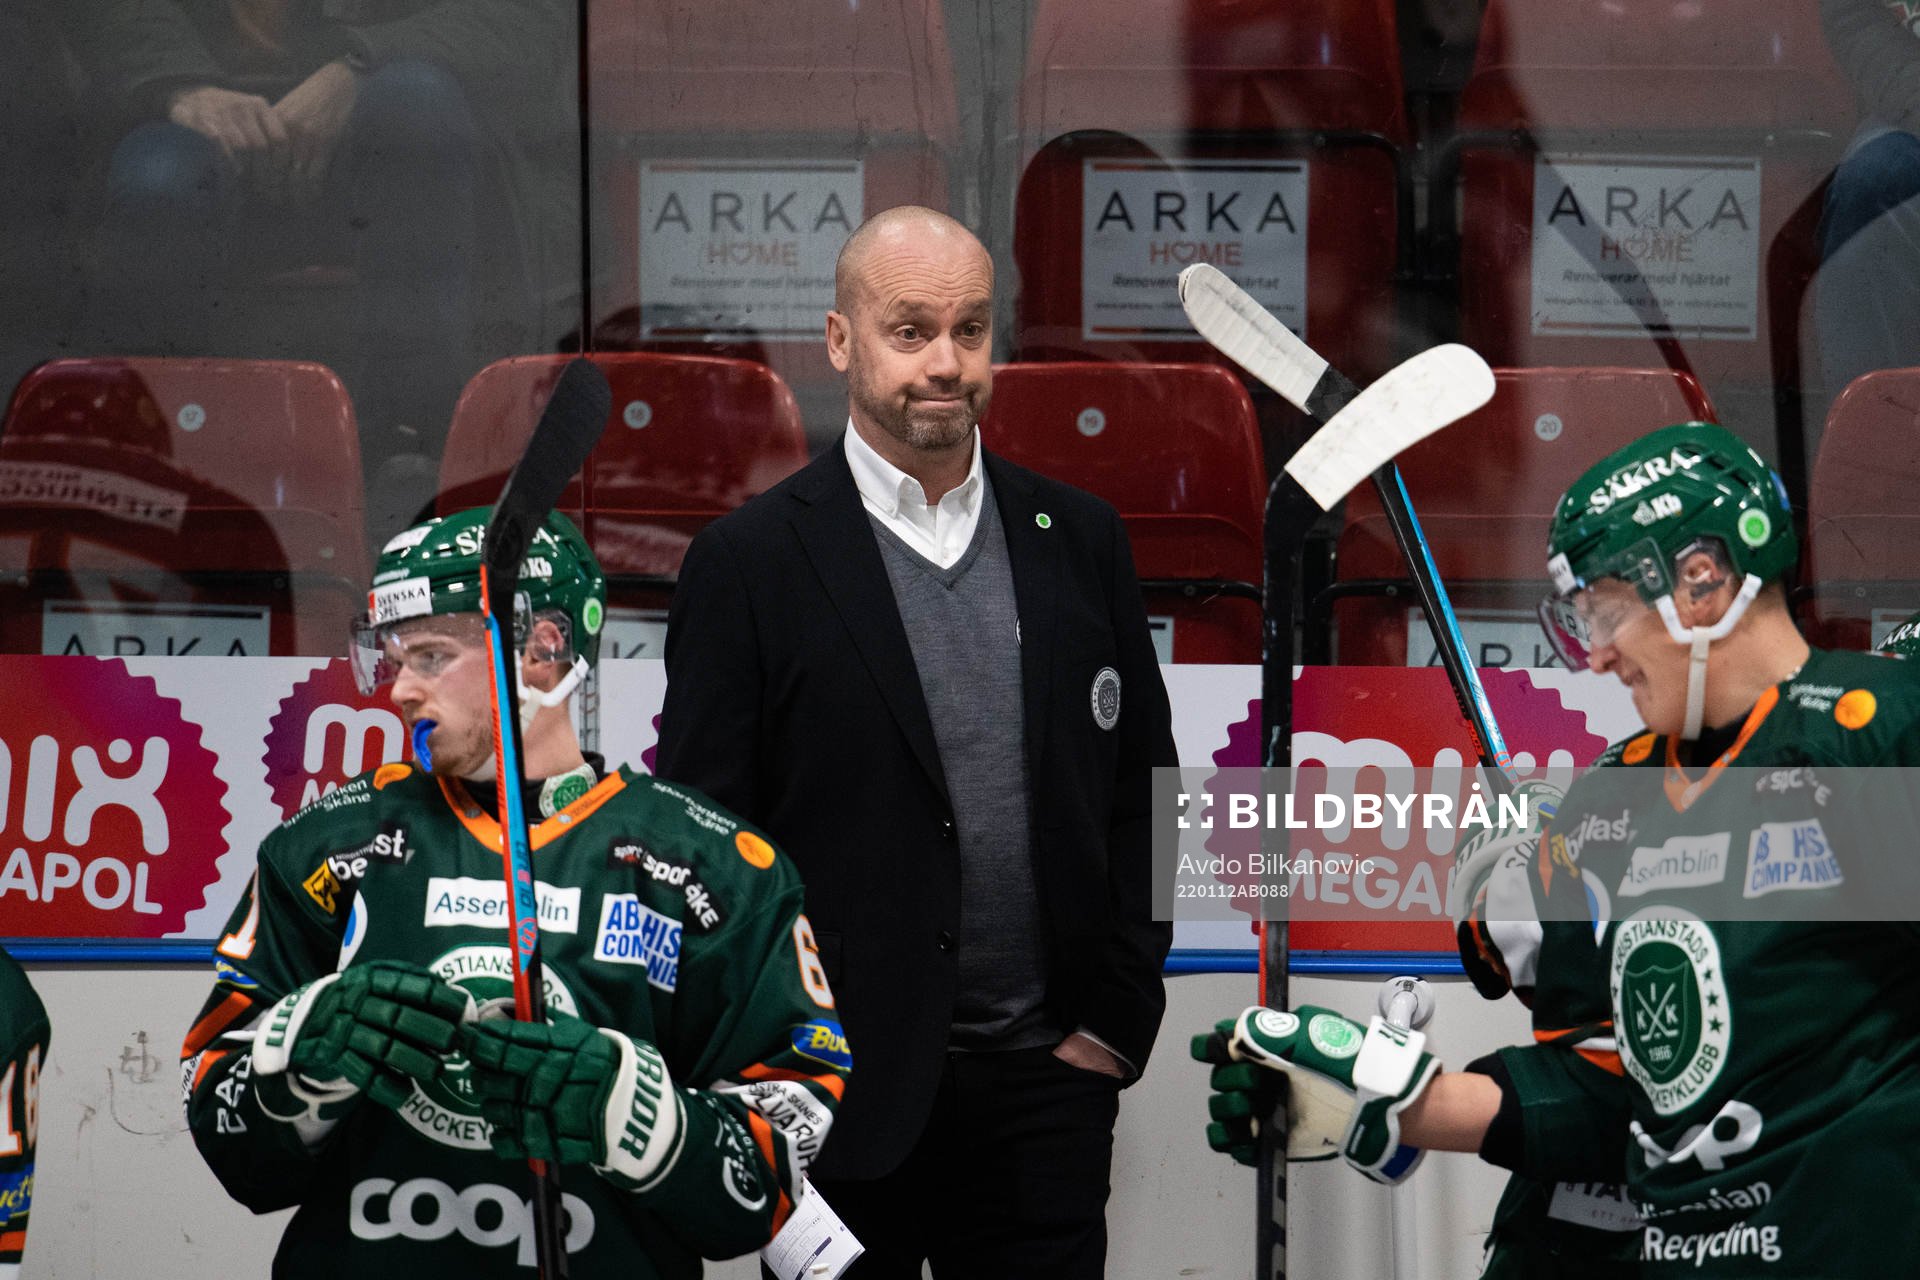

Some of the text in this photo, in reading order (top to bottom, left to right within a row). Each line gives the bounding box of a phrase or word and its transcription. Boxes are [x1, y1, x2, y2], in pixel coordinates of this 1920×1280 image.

[653, 190, 853, 233] ARKA
[1096, 189, 1297, 234] ARKA
[1547, 185, 1748, 230] ARKA
[376, 587, 426, 606] SVENSKA
[606, 900, 640, 930] AB
[793, 913, 836, 1010] 6
[350, 1177, 595, 1268] coop
[1643, 1222, 1782, 1267] Recycling
